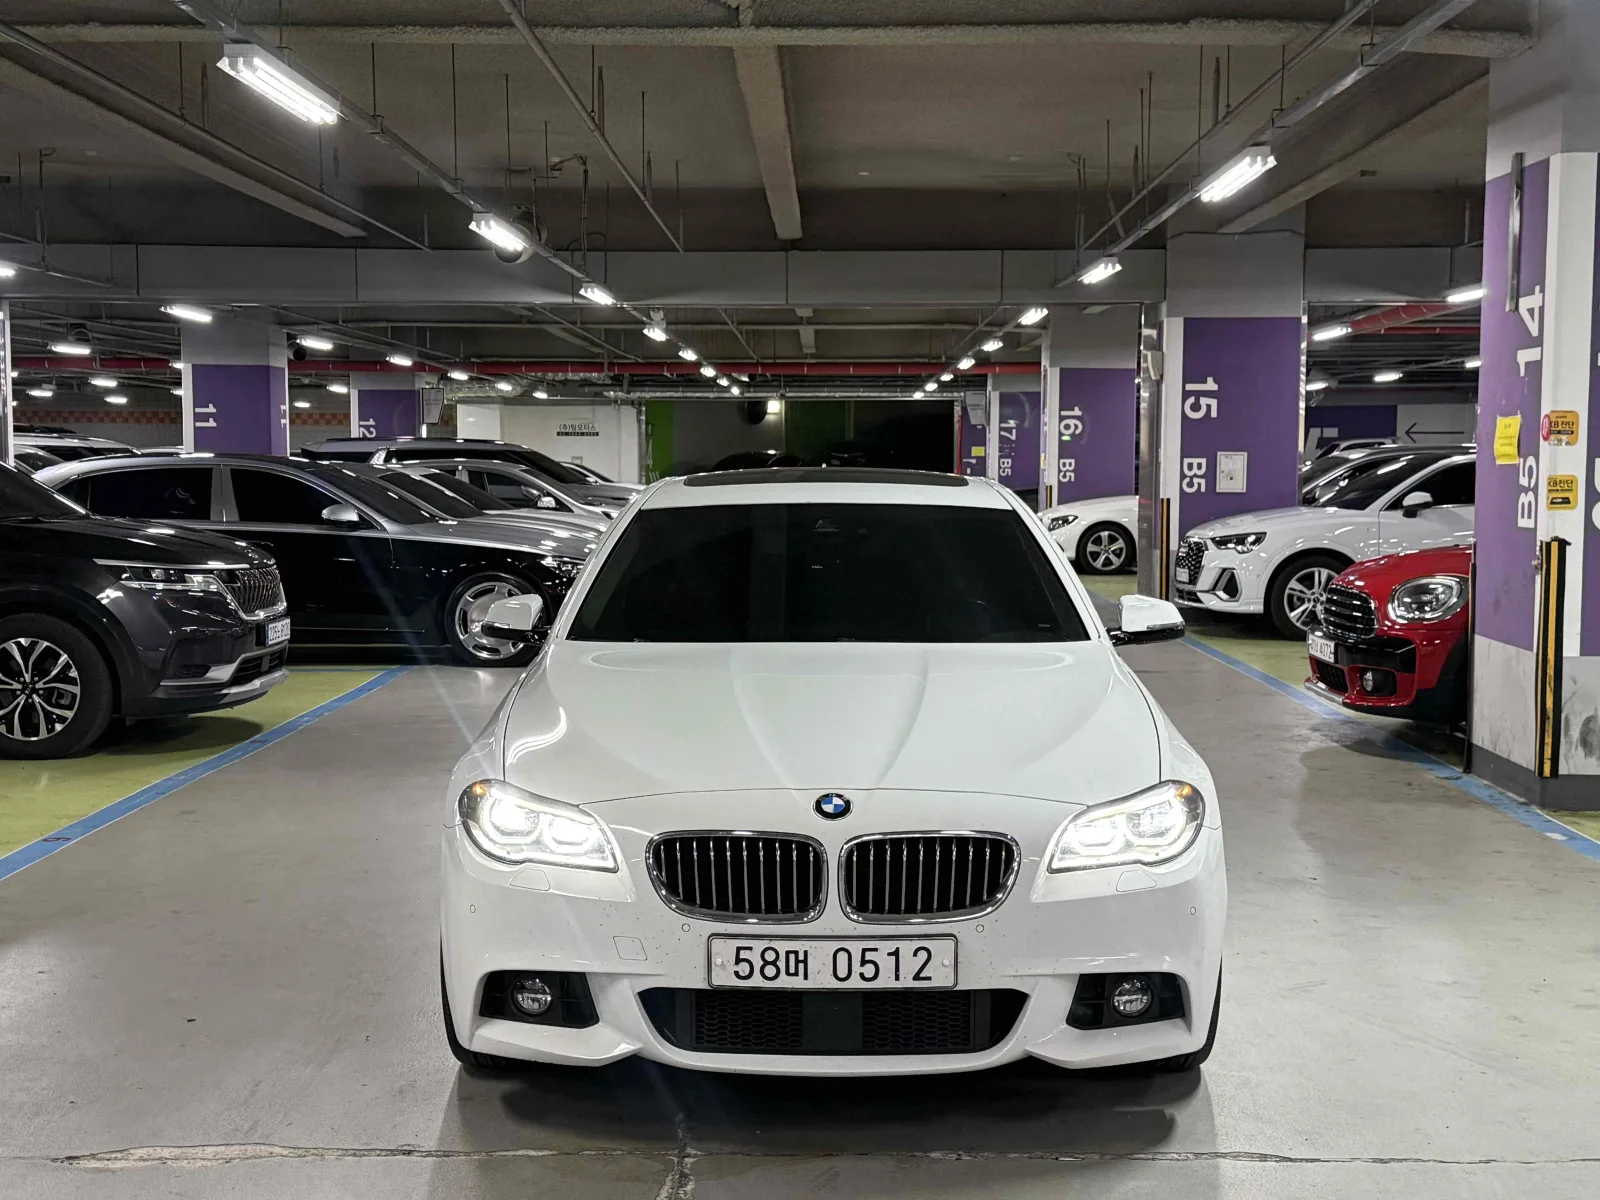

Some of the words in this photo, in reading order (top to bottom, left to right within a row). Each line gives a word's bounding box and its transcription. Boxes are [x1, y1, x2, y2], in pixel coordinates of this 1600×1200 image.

[1517, 285, 1543, 377] 14
[1184, 376, 1219, 419] 15
[194, 403, 217, 427] 11
[359, 417, 377, 438] 12
[1060, 406, 1083, 435] 16
[1000, 420, 1017, 440] 17
[999, 458, 1012, 477] B5
[1059, 458, 1076, 482] B5
[1182, 457, 1207, 493] B5
[1517, 455, 1538, 529] B5
[733, 945, 809, 981] 58머
[832, 945, 933, 982] 0512
